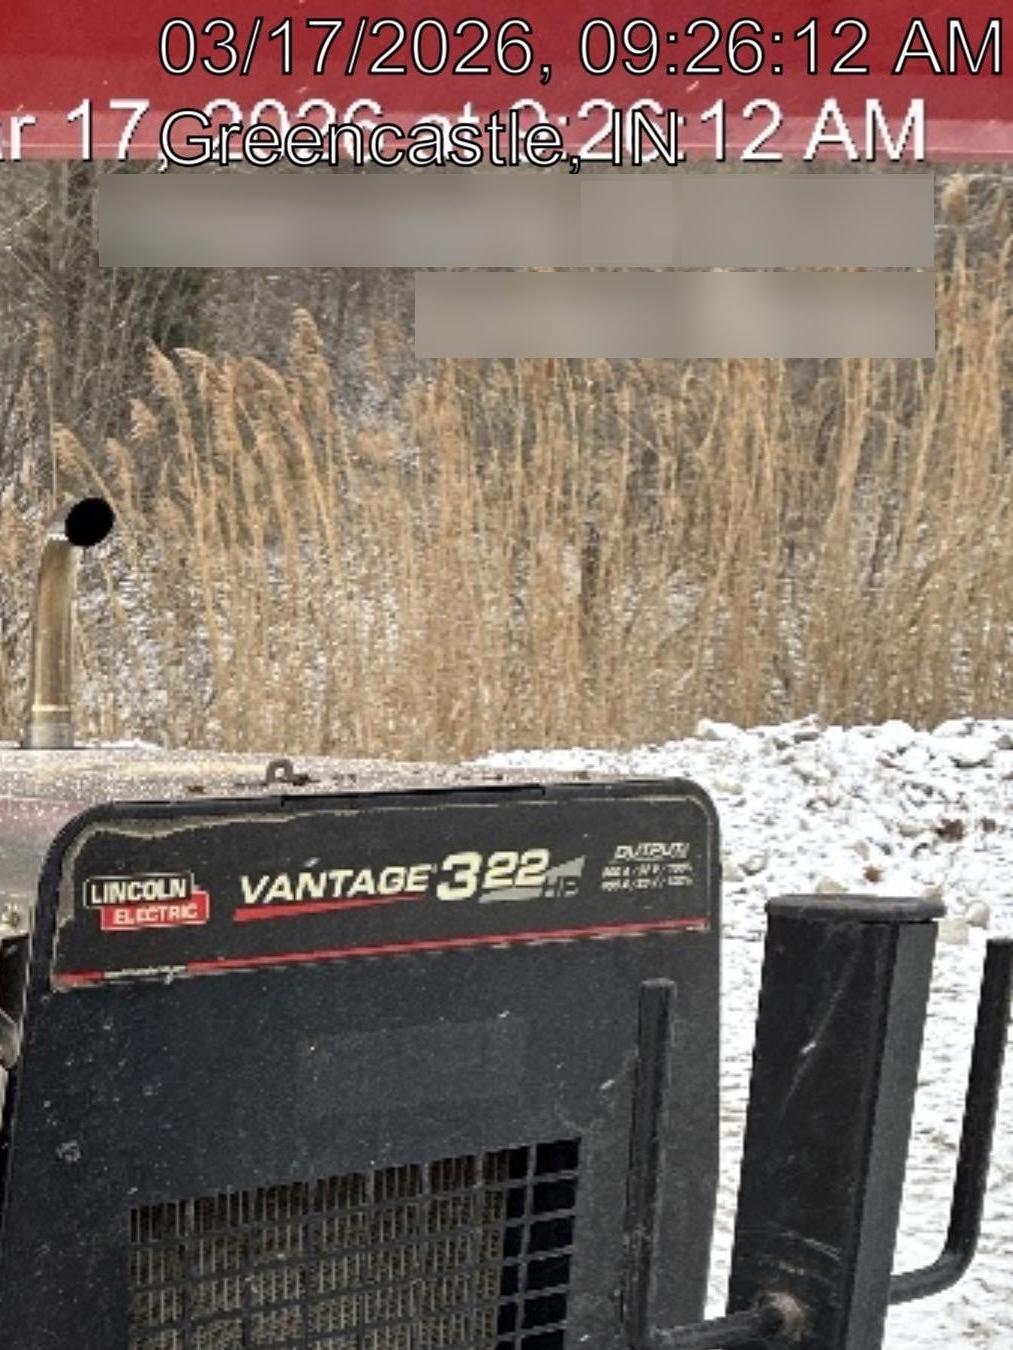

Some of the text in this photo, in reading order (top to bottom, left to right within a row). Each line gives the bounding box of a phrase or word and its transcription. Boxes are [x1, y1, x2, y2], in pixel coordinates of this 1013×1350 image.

[240, 863, 430, 904] VANTAGE
[437, 848, 550, 901] 322
[91, 878, 187, 905] LINCOLN
[113, 903, 199, 925] ELECTRIC
